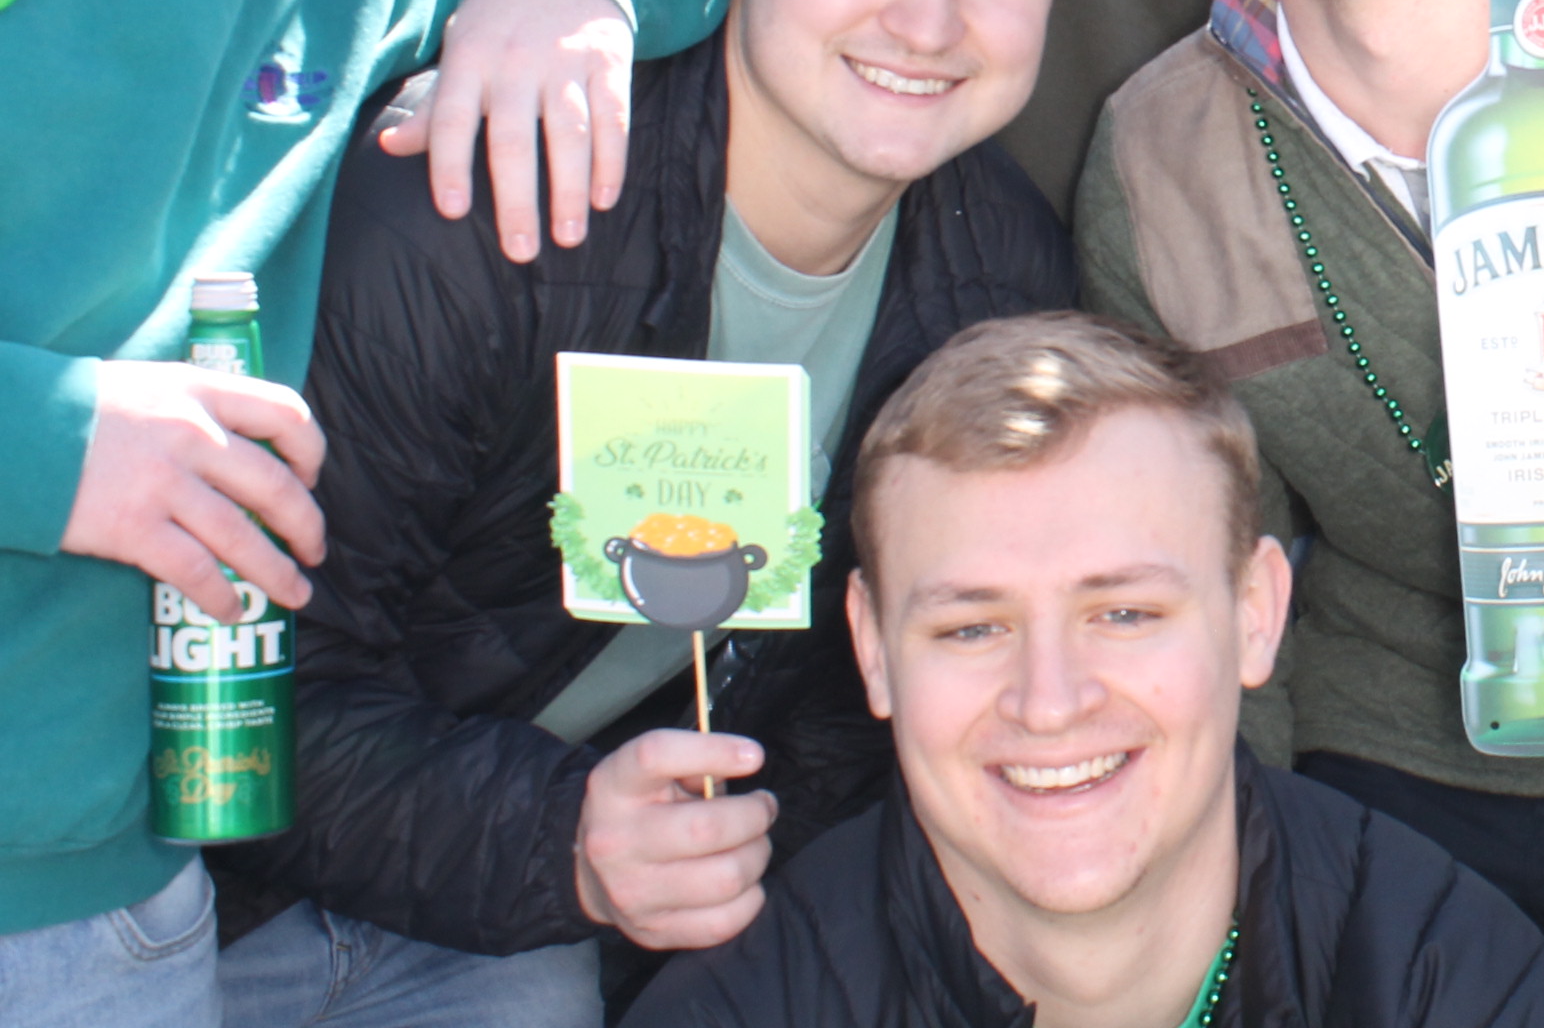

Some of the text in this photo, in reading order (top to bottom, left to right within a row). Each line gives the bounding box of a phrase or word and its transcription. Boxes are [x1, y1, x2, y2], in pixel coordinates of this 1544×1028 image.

[655, 418, 709, 437] HAPPY
[642, 439, 768, 473] Patrick's
[1493, 452, 1518, 463] JOHN
[657, 477, 713, 508] DAY
[1498, 556, 1544, 598] John
